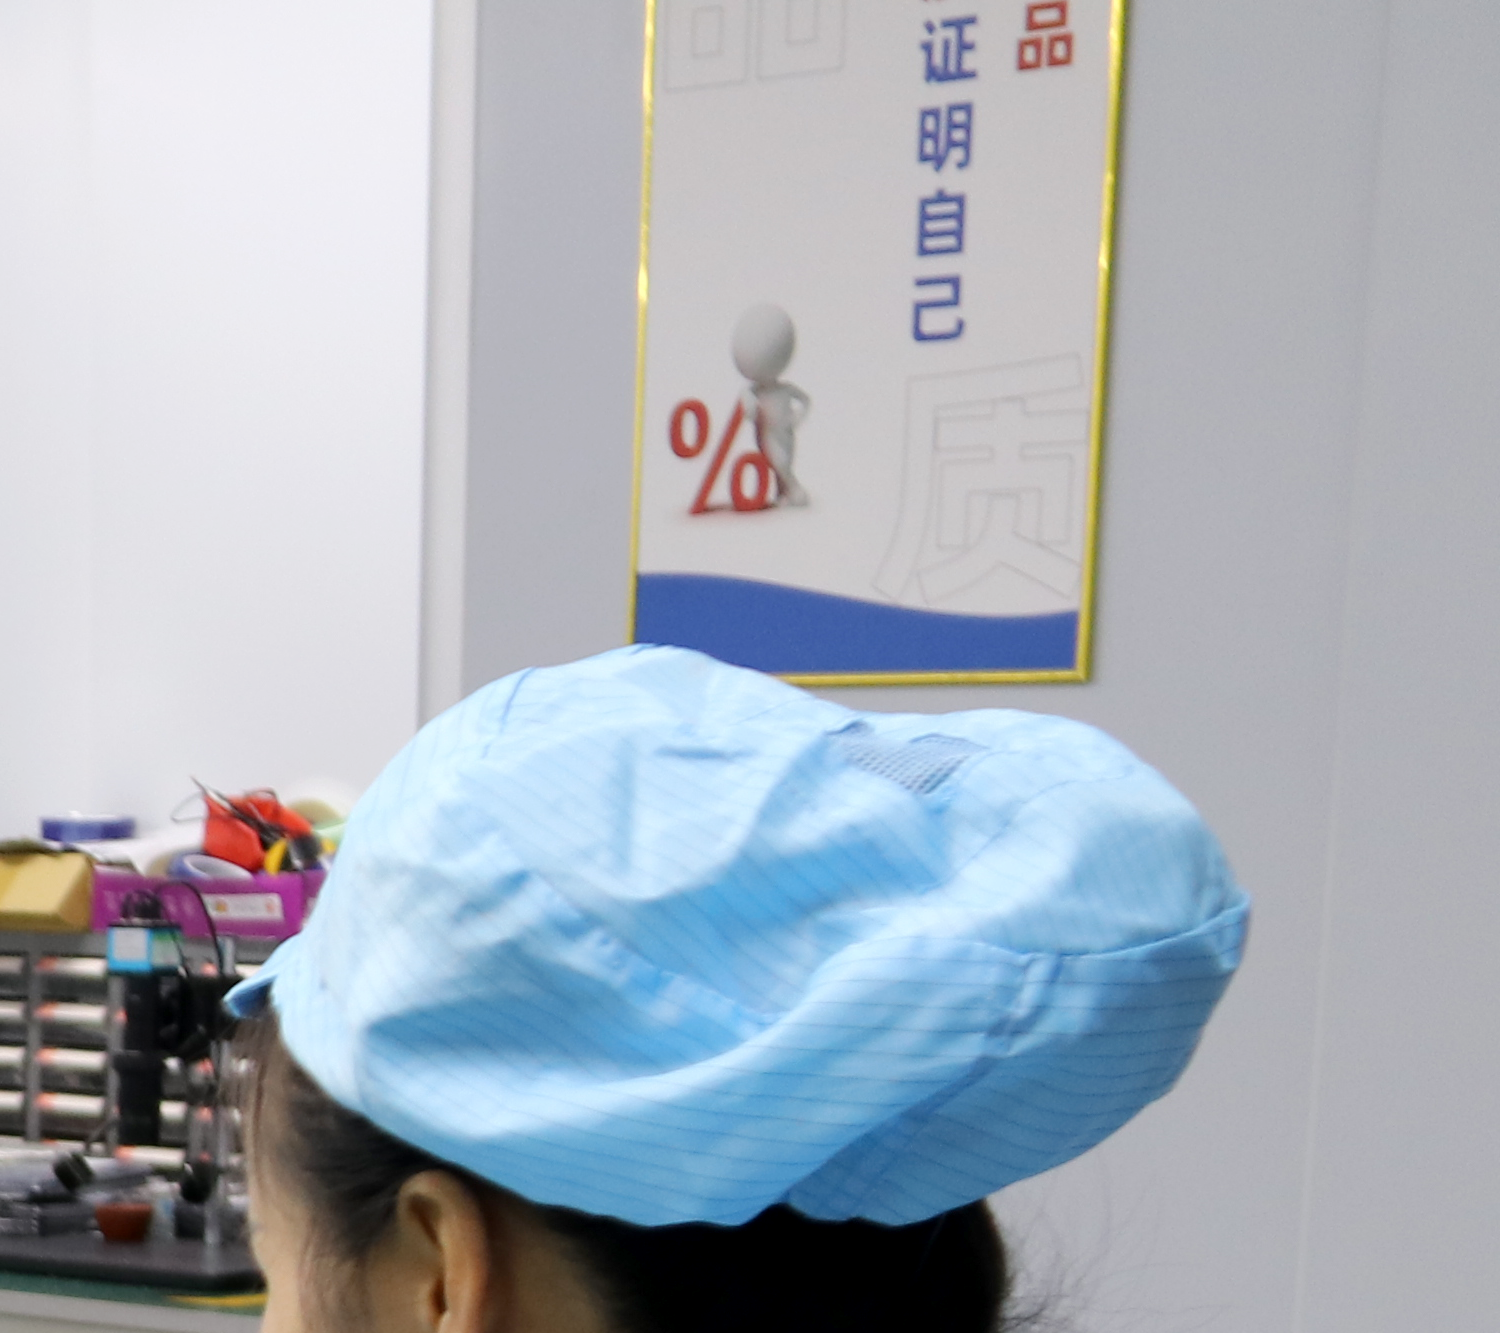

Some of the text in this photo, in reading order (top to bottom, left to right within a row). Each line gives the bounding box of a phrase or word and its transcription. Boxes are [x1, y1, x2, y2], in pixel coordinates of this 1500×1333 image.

[1017, 1, 1073, 71] 品
[912, 14, 978, 342] 证明自己
